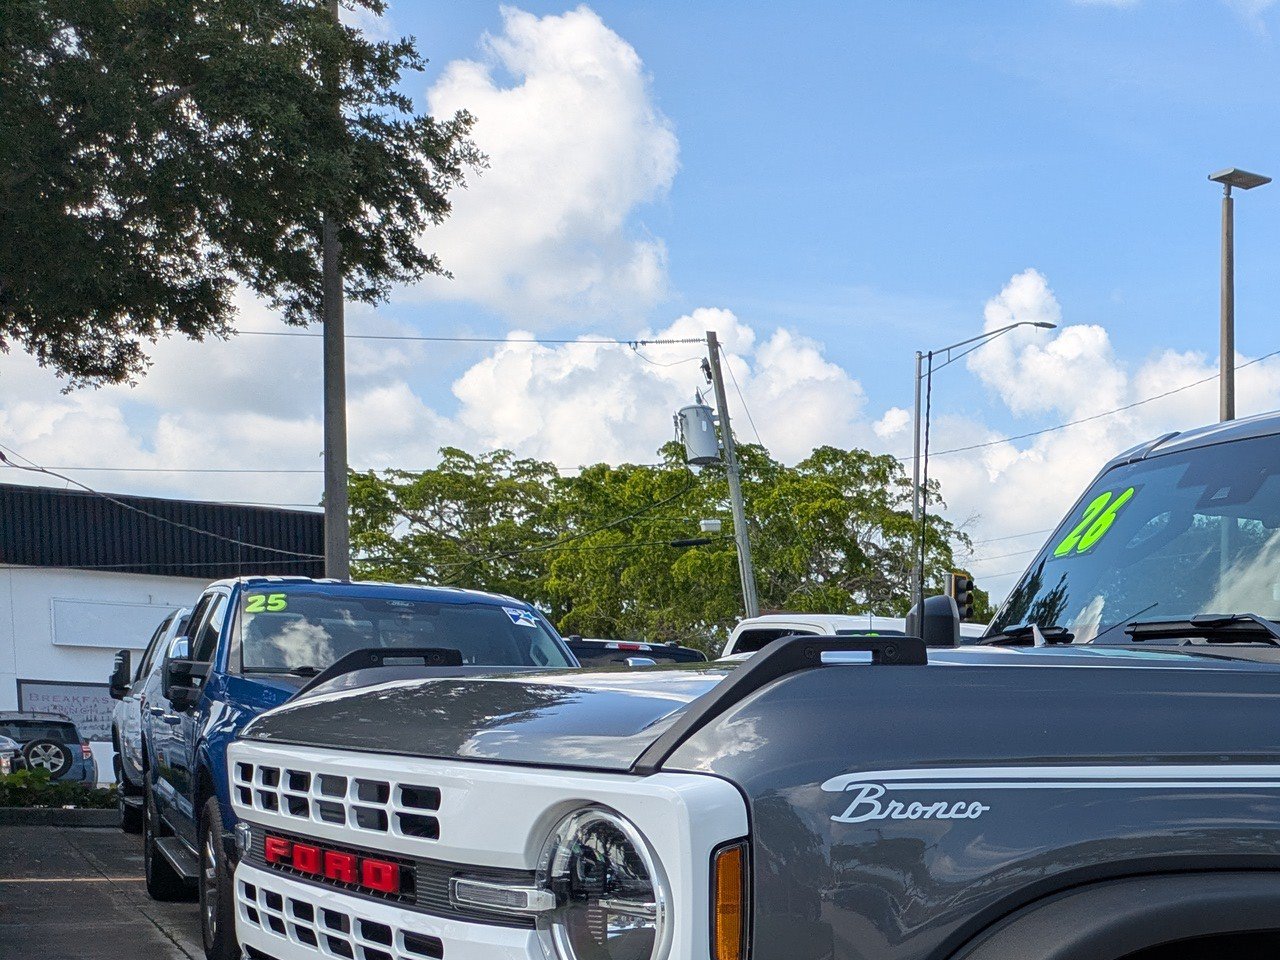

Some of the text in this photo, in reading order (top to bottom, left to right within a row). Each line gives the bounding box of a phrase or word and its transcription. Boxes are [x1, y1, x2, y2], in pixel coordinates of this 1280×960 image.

[1053, 487, 1134, 557] 26
[245, 593, 287, 613] 25
[830, 783, 990, 823] Bronco
[265, 835, 399, 893] FORD
